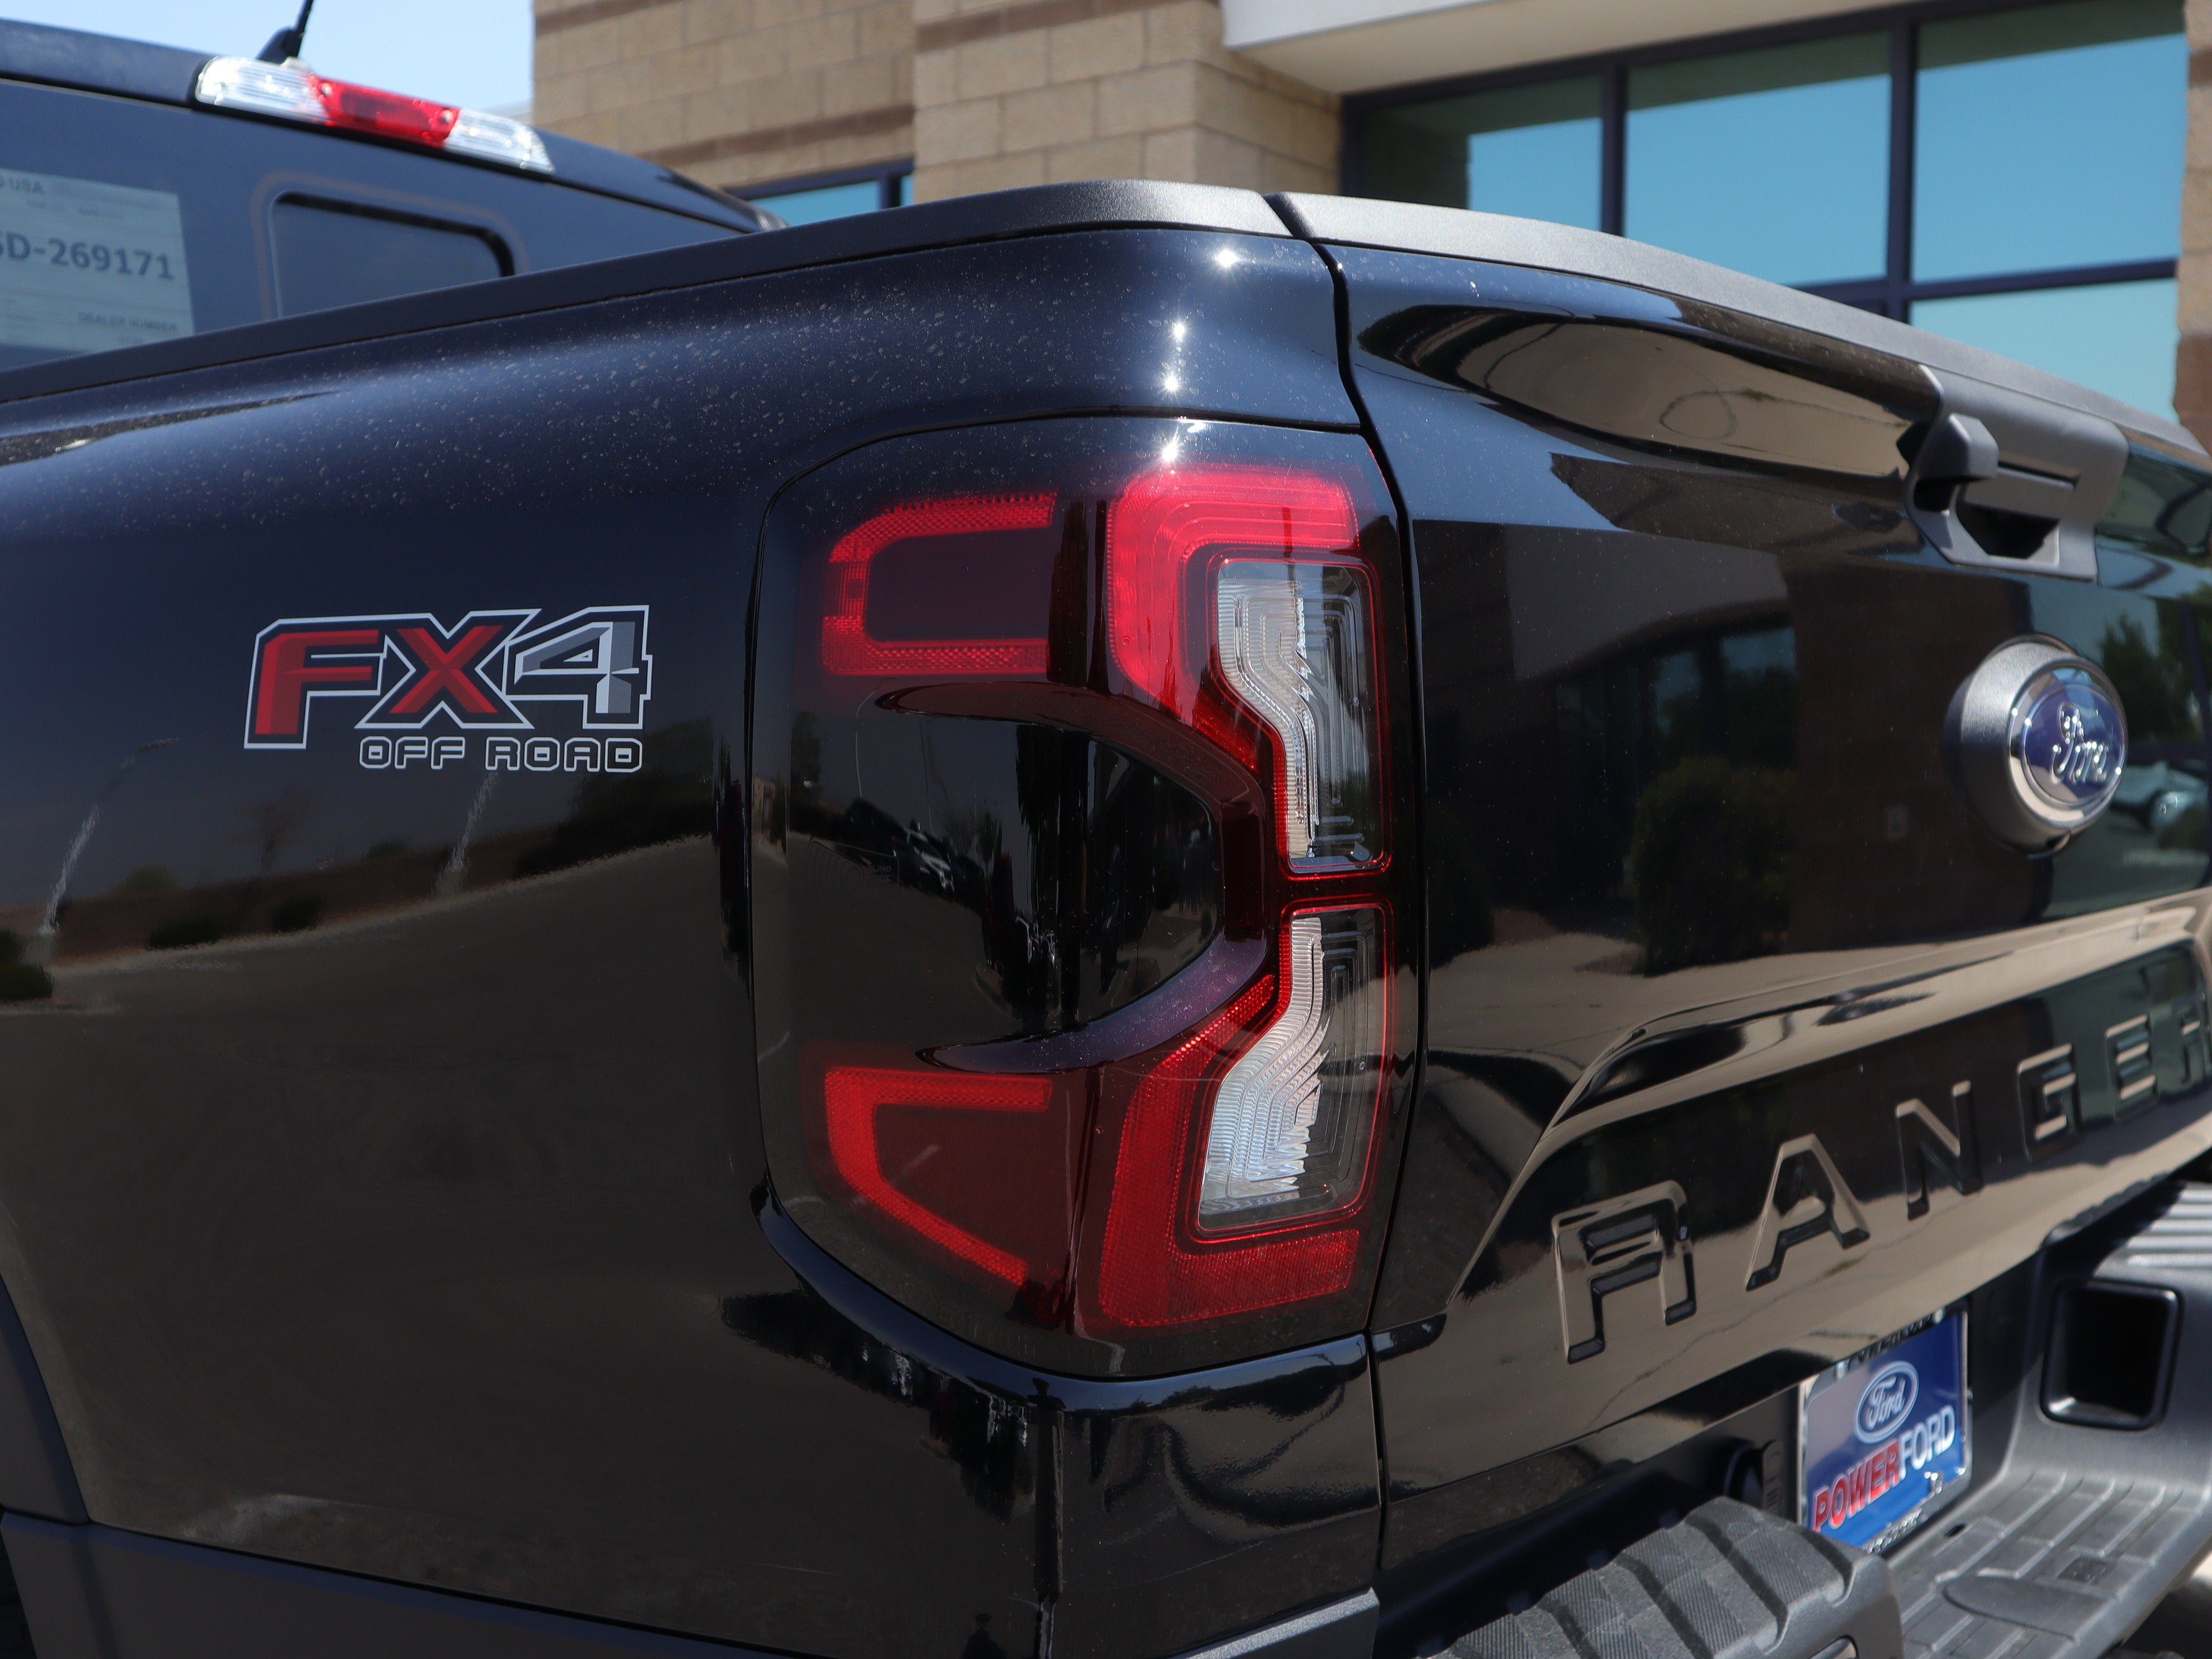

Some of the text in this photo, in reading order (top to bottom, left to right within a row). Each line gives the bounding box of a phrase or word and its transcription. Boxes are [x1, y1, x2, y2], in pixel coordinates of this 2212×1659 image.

[0, 230, 175, 281] D-269171
[243, 605, 653, 749] FX4
[359, 736, 643, 772] OFF ROAD
[1867, 1375, 1906, 1431] Ford
